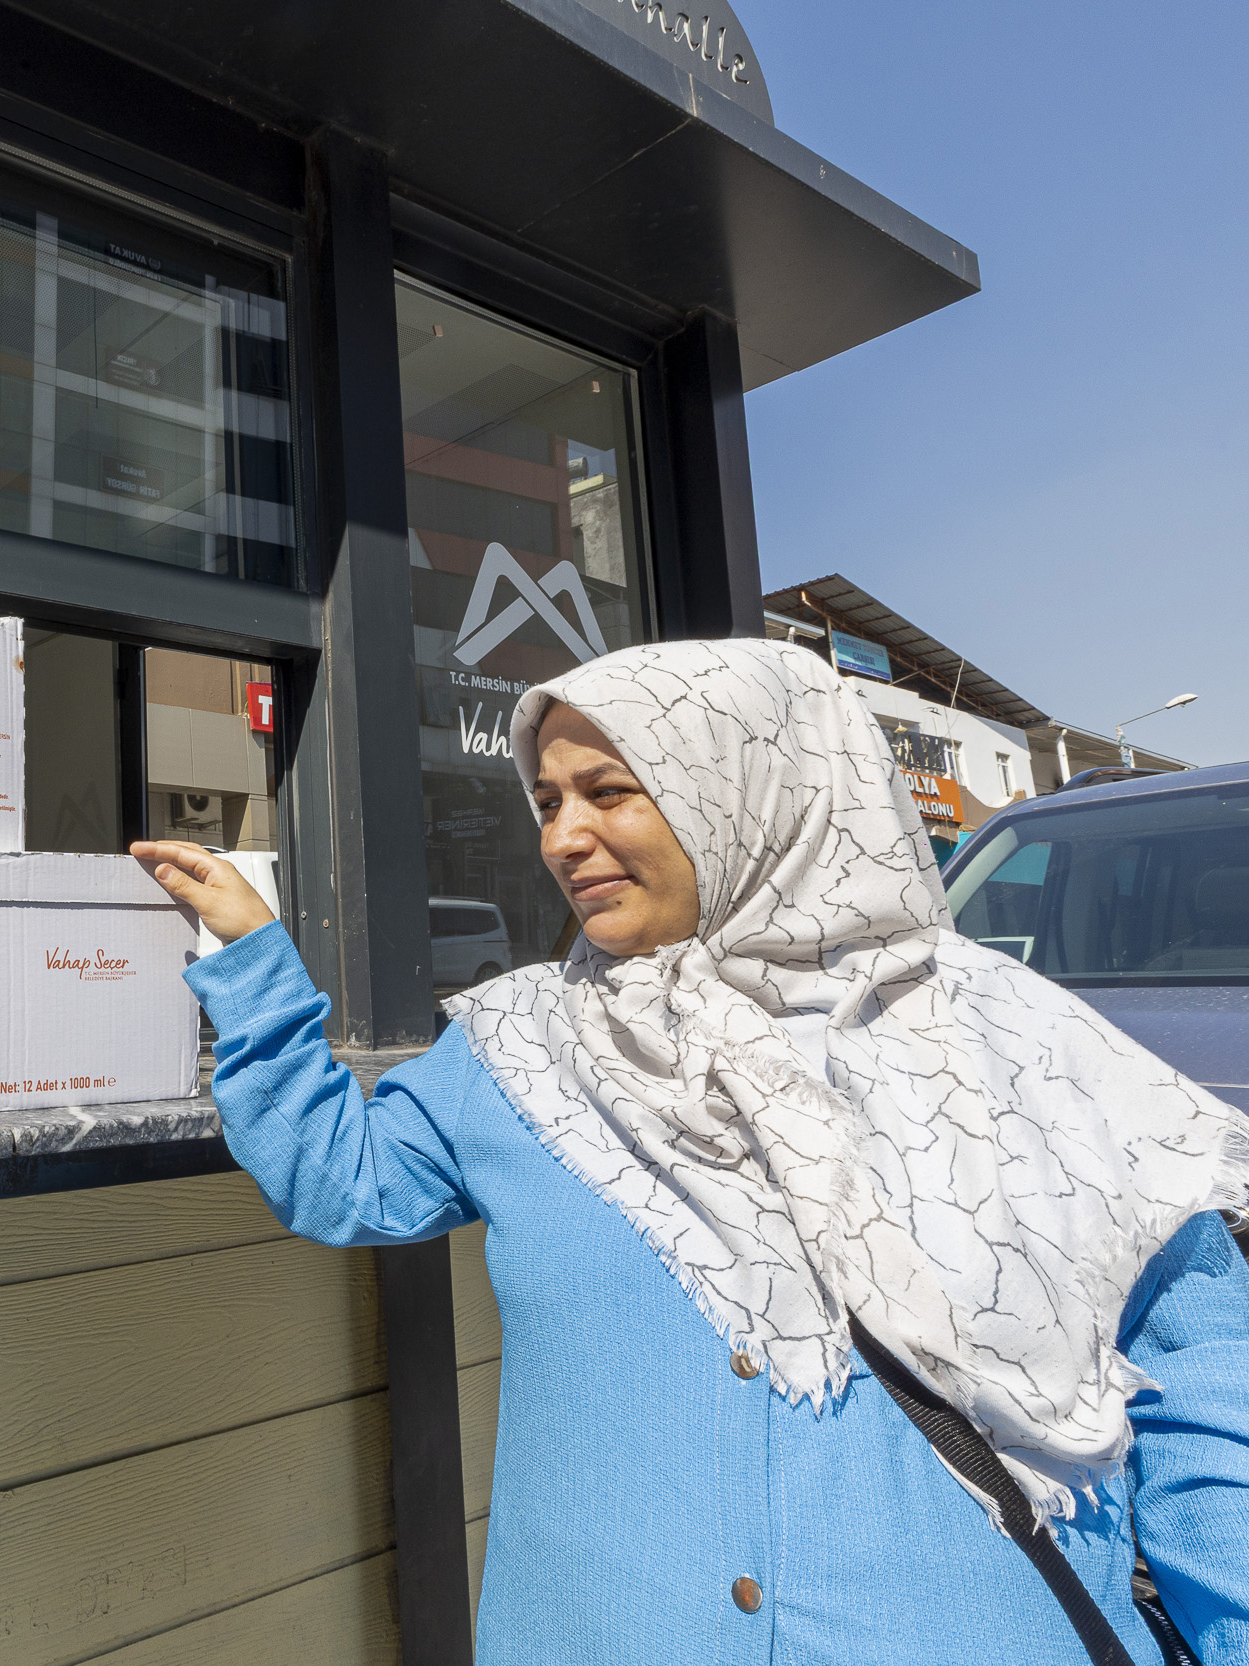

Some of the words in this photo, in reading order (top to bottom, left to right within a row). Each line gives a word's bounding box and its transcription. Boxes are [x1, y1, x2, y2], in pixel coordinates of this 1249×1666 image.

[450, 672, 468, 686] T.C.
[471, 676, 511, 693] MERSİN
[46, 947, 91, 979] Vahap
[93, 949, 129, 970] Seçer
[0, 1082, 20, 1094] Net:
[23, 1080, 32, 1092] 12
[36, 1080, 58, 1091] Adet
[70, 1076, 90, 1089] 1000
[94, 1076, 105, 1088] ml
